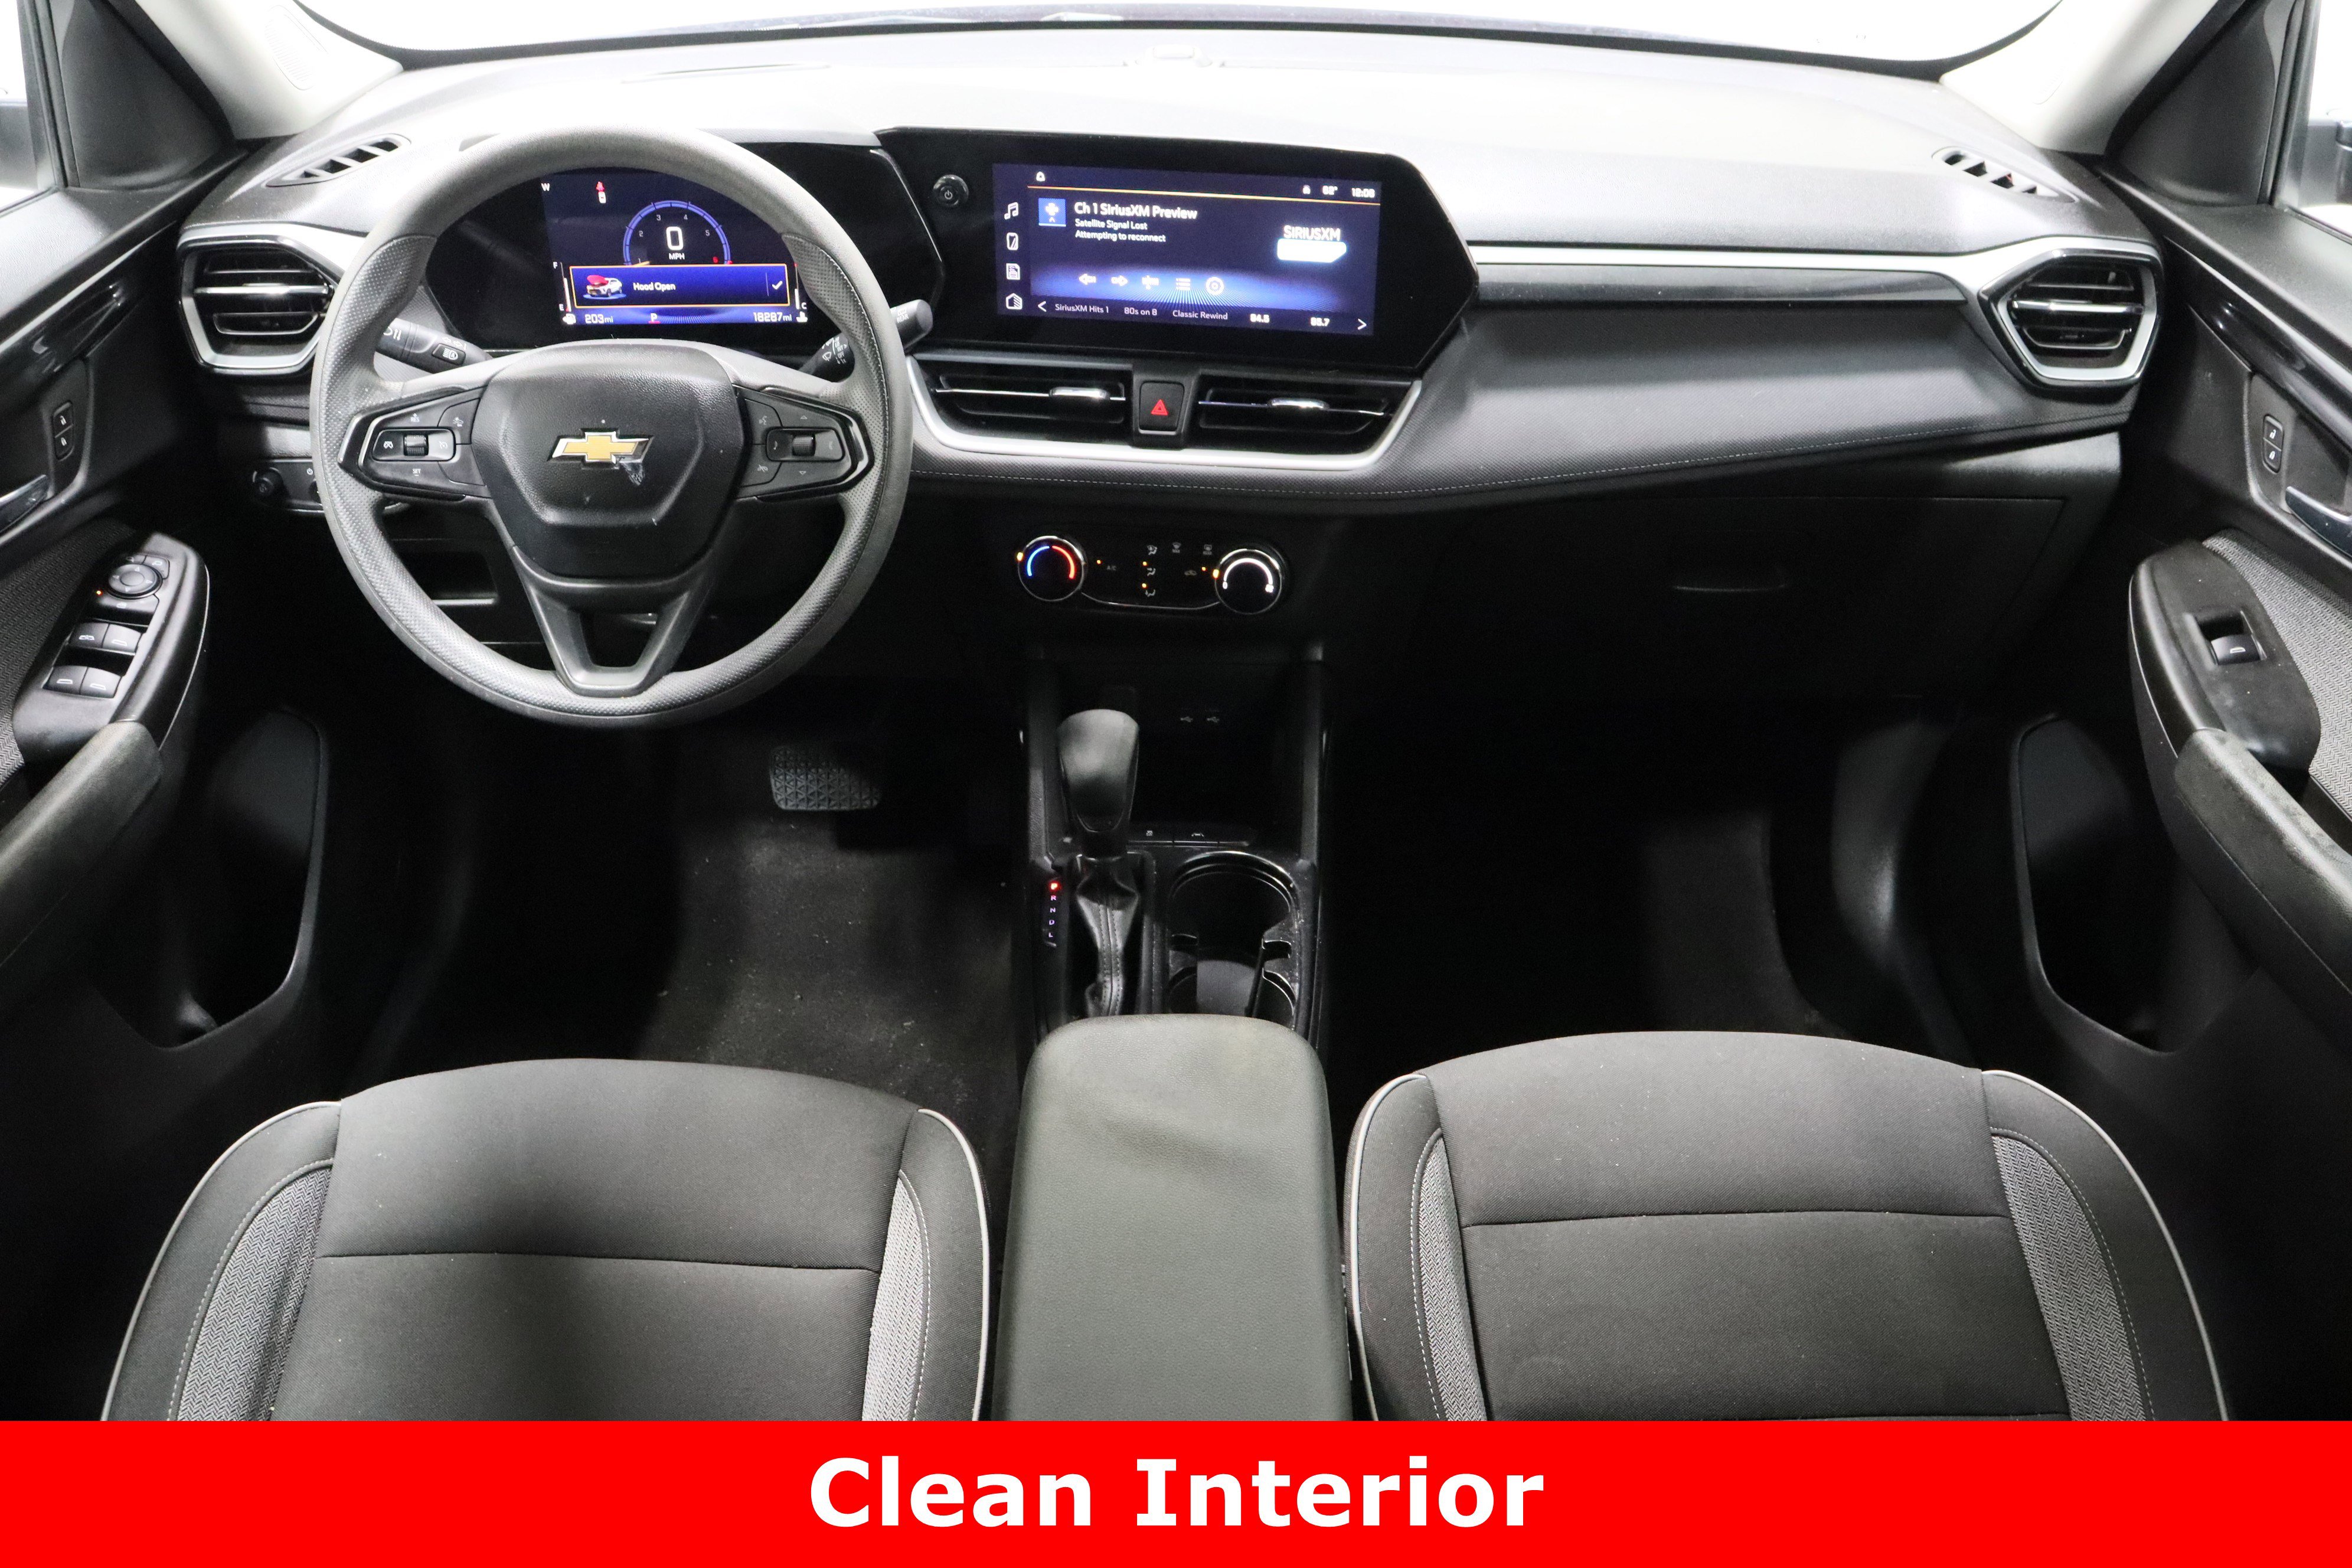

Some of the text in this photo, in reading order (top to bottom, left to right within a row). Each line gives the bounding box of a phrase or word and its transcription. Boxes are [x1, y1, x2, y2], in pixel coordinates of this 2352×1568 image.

[541, 183, 550, 191] W
[1074, 202, 1197, 219] Ch 1 SiriusXM Preview
[1075, 218, 1148, 230] Satellite Signal Lost
[1075, 230, 1166, 242] Attempting to reconnect
[1284, 225, 1340, 241] SIRIUSXM
[666, 227, 684, 250] 0
[633, 282, 676, 292] Hood Open
[1055, 303, 1087, 312] SiriusXM
[651, 313, 658, 322] P
[897, 313, 909, 323] REAR
[1172, 310, 1228, 320] Classic Rewind
